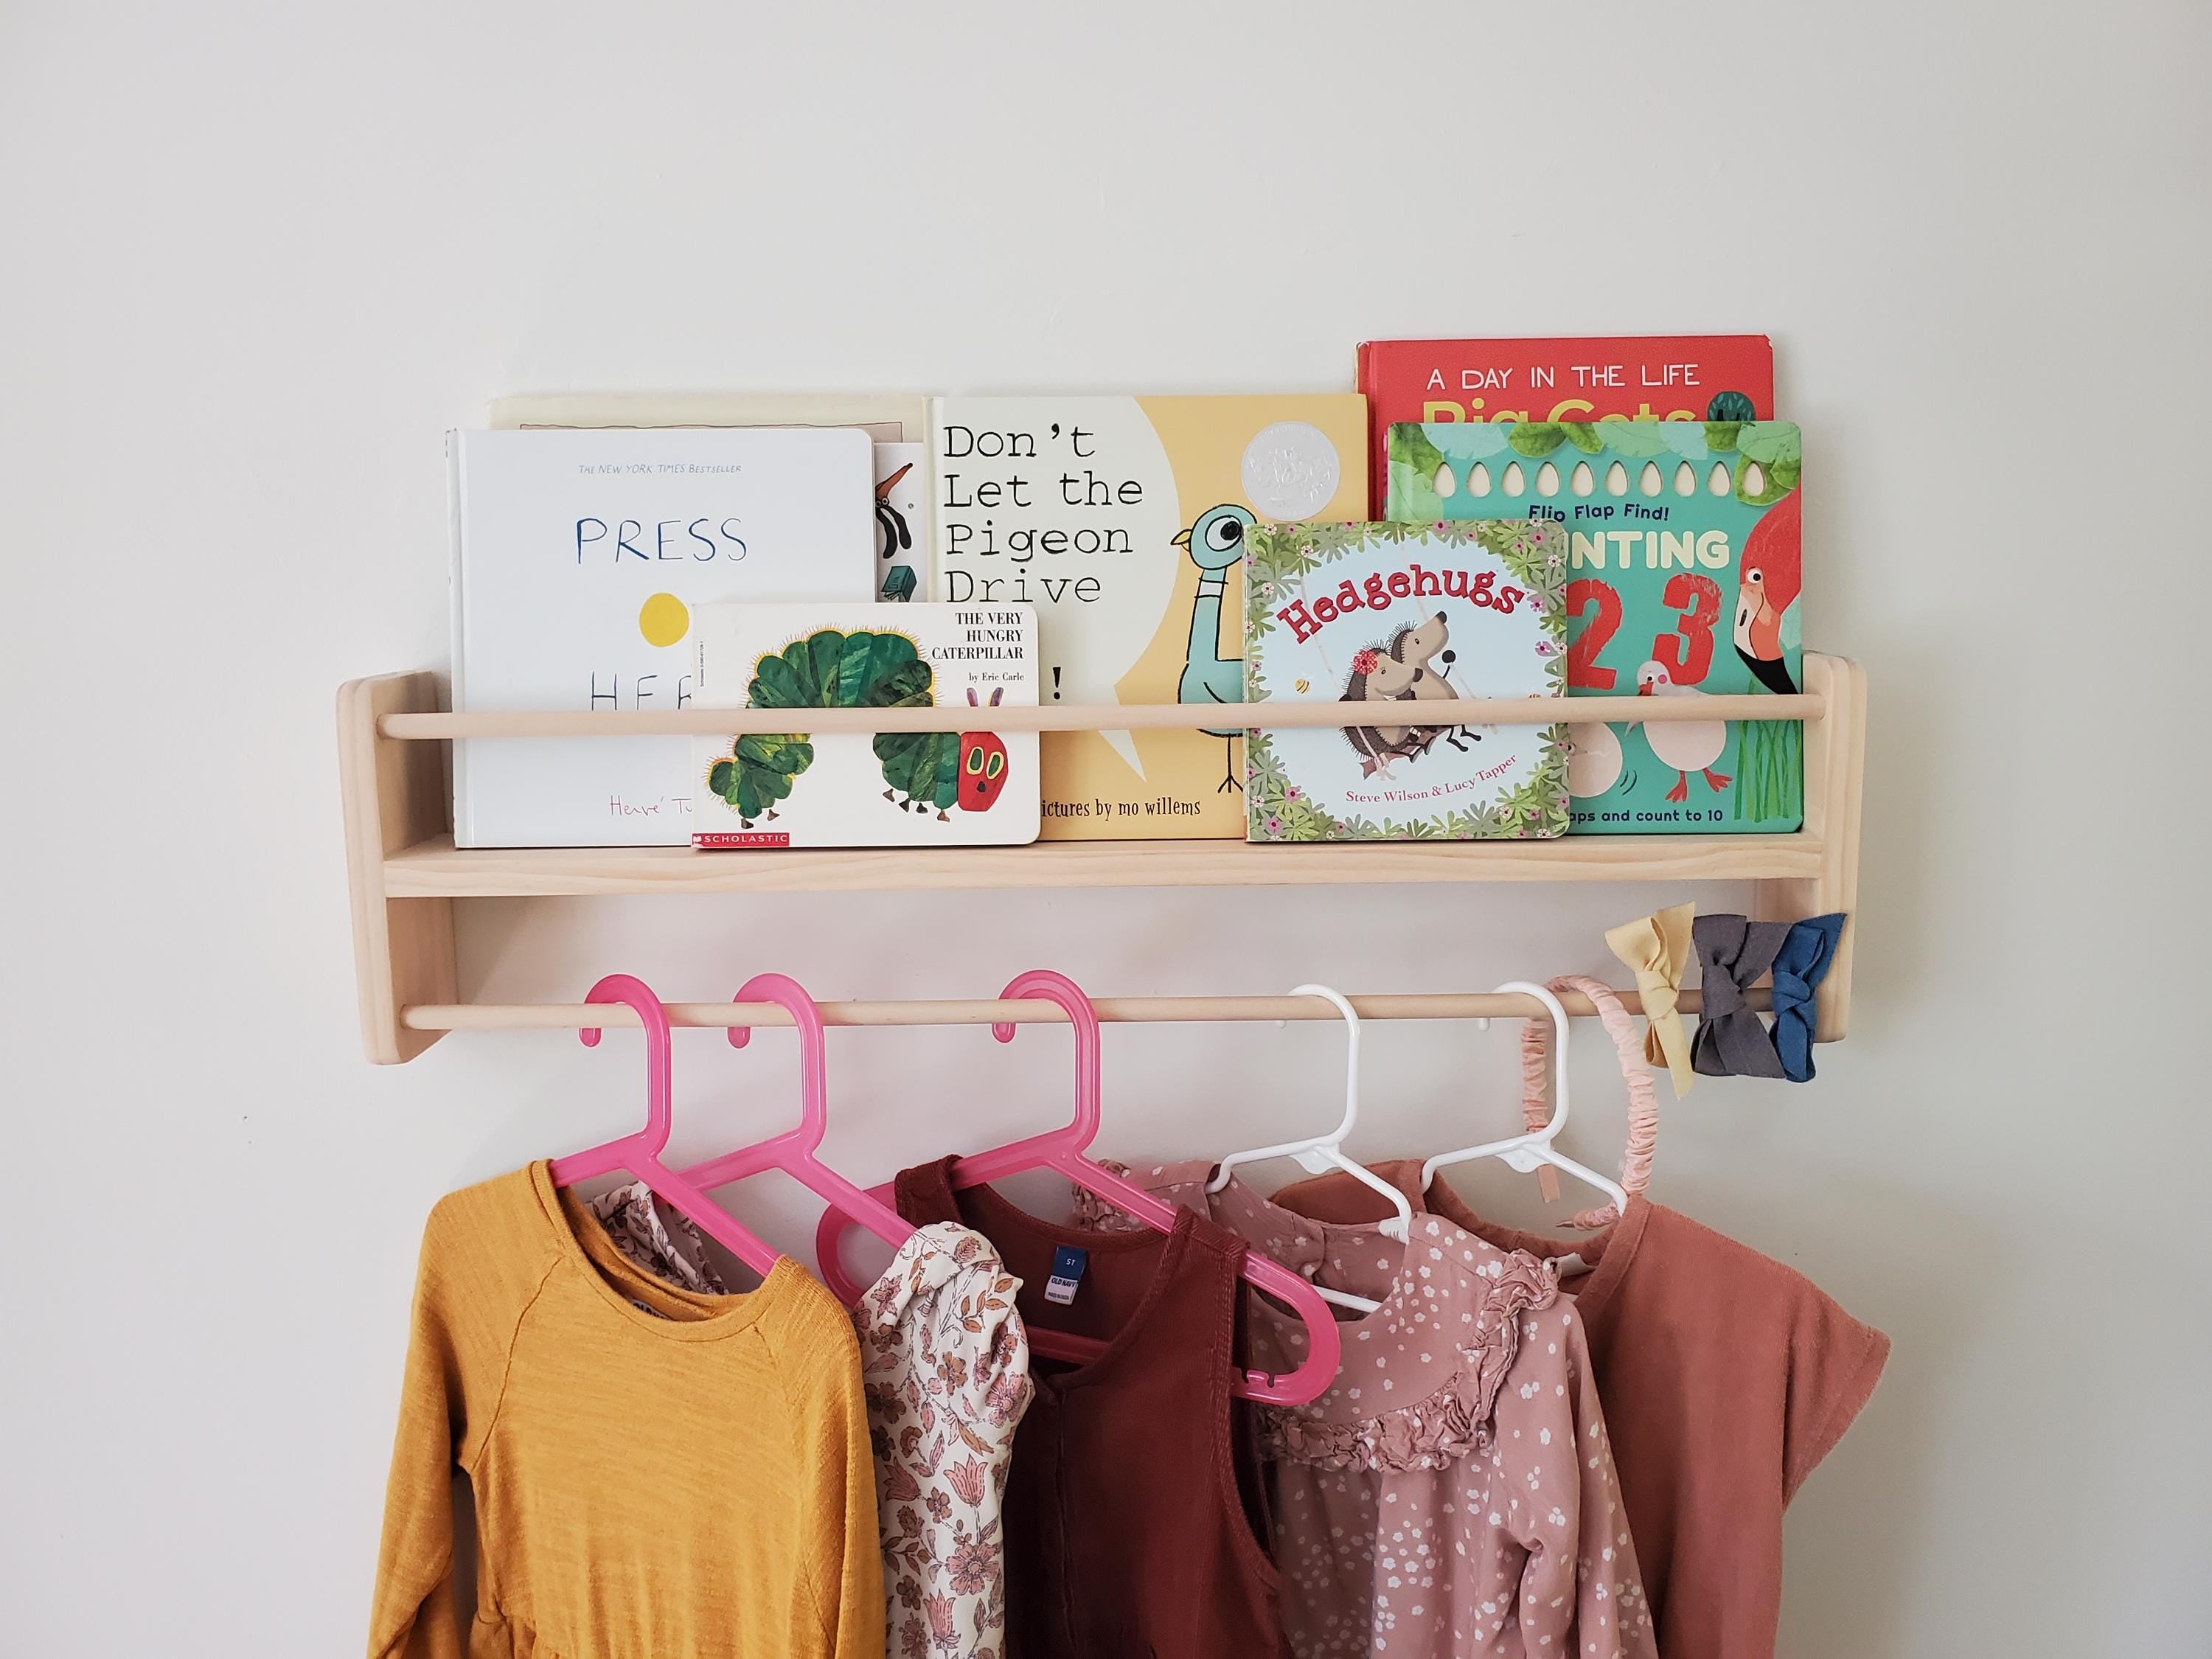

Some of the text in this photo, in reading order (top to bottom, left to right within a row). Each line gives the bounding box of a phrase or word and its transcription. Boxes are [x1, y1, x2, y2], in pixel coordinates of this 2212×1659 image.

[1427, 364, 1700, 390] A DAY IN THE LIFE
[943, 422, 1096, 457] Don't
[598, 465, 622, 474] NEW
[626, 464, 653, 473] YORK
[658, 464, 686, 473] TIMES
[943, 470, 1143, 508] Let the
[1528, 503, 1670, 523] Flip Flap Find!
[577, 518, 747, 564] PRESS
[946, 519, 1134, 563] Pigeon
[1565, 530, 1731, 570] NTING
[944, 568, 1102, 604] Drive
[1276, 564, 1525, 645] Hedgehugs
[956, 612, 1023, 625] THE VERY
[1566, 571, 1722, 690] 2 3
[966, 630, 1023, 642] HUNGRY
[932, 647, 1024, 660] CATERPILLAR
[969, 672, 1025, 684] by Eric Carle
[1346, 754, 1517, 803] Steve Wilson & Lucy Tapper
[1095, 799, 1113, 821] by
[1118, 801, 1140, 816] mo
[1144, 797, 1201, 816] willems
[1601, 810, 1630, 822] and
[1635, 810, 1680, 822] count
[1686, 810, 1703, 822] to
[1708, 810, 1724, 822] 10
[704, 835, 787, 843] SCHOLASTIC
[1051, 1277, 1077, 1288] OLD NAVY
